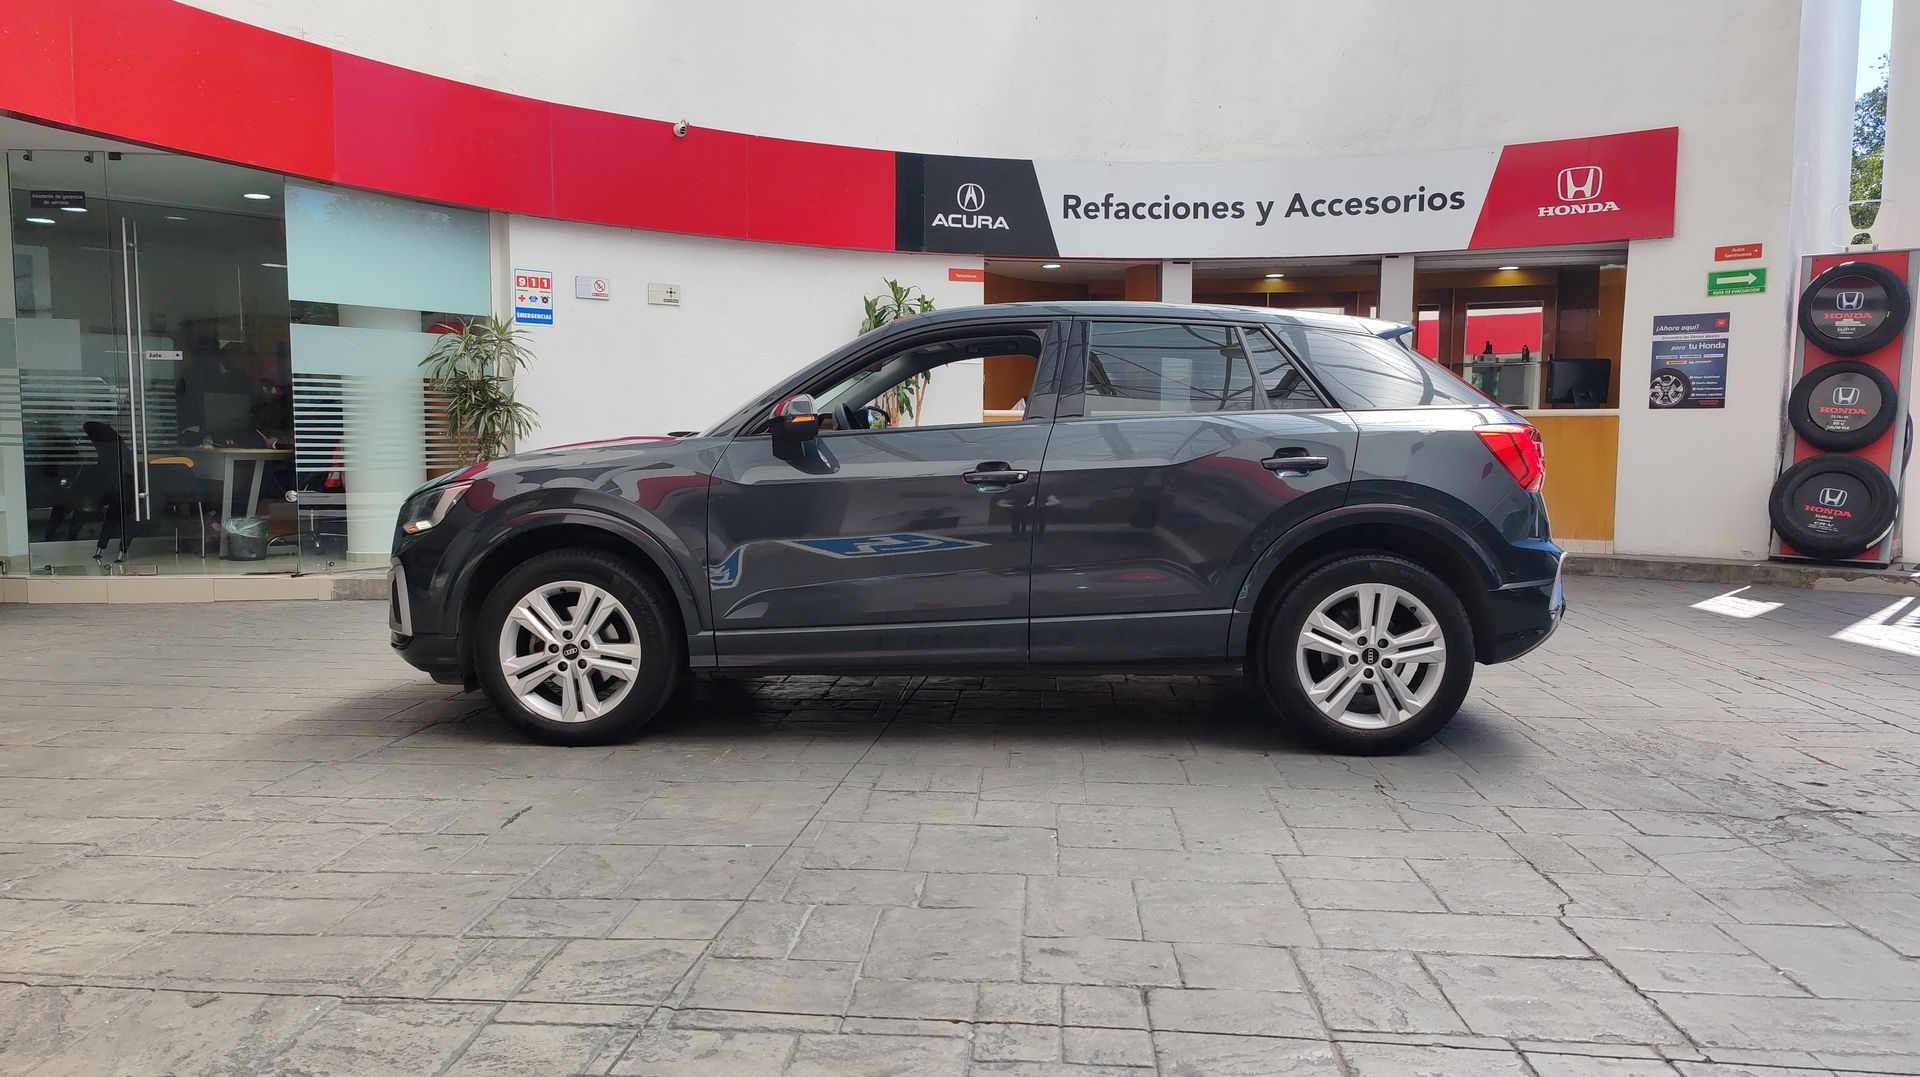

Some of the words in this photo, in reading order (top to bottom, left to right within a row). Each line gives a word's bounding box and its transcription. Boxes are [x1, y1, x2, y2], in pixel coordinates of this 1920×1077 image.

[1063, 193, 1245, 220] Refacciones
[1255, 201, 1274, 226] y
[1284, 185, 1466, 218] Accesorios
[1537, 200, 1621, 217] HONDA
[931, 213, 1010, 230] ACURA
[518, 277, 549, 289] 911
[517, 312, 552, 320] EMERGENCIAS
[1681, 323, 1700, 331] aquí!
[1699, 341, 1726, 349] Honda
[1819, 406, 1867, 415] HONDA
[1804, 504, 1853, 518] HONDA
